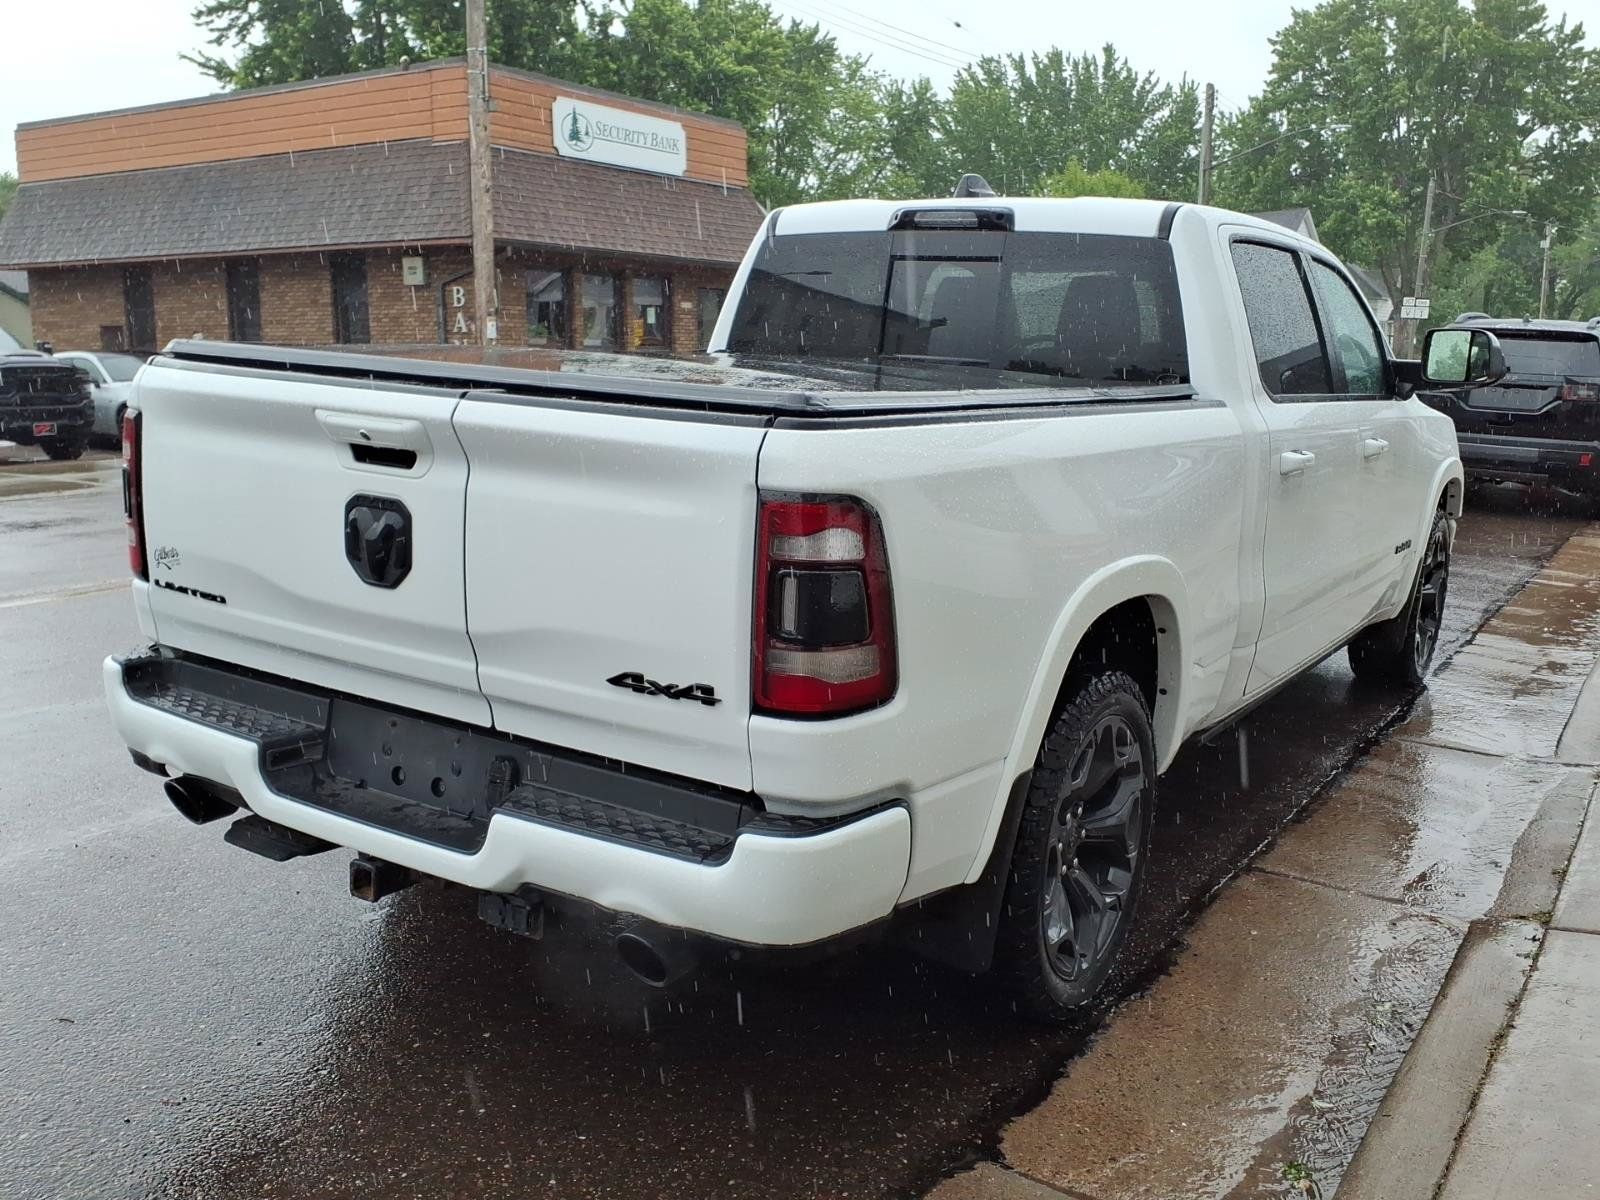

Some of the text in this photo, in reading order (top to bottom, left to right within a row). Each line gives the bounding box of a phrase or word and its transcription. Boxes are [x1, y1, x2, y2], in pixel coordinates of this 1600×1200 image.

[595, 120, 679, 152] SECURITY BANK
[452, 286, 469, 346] BA
[154, 578, 227, 605] LIMITED
